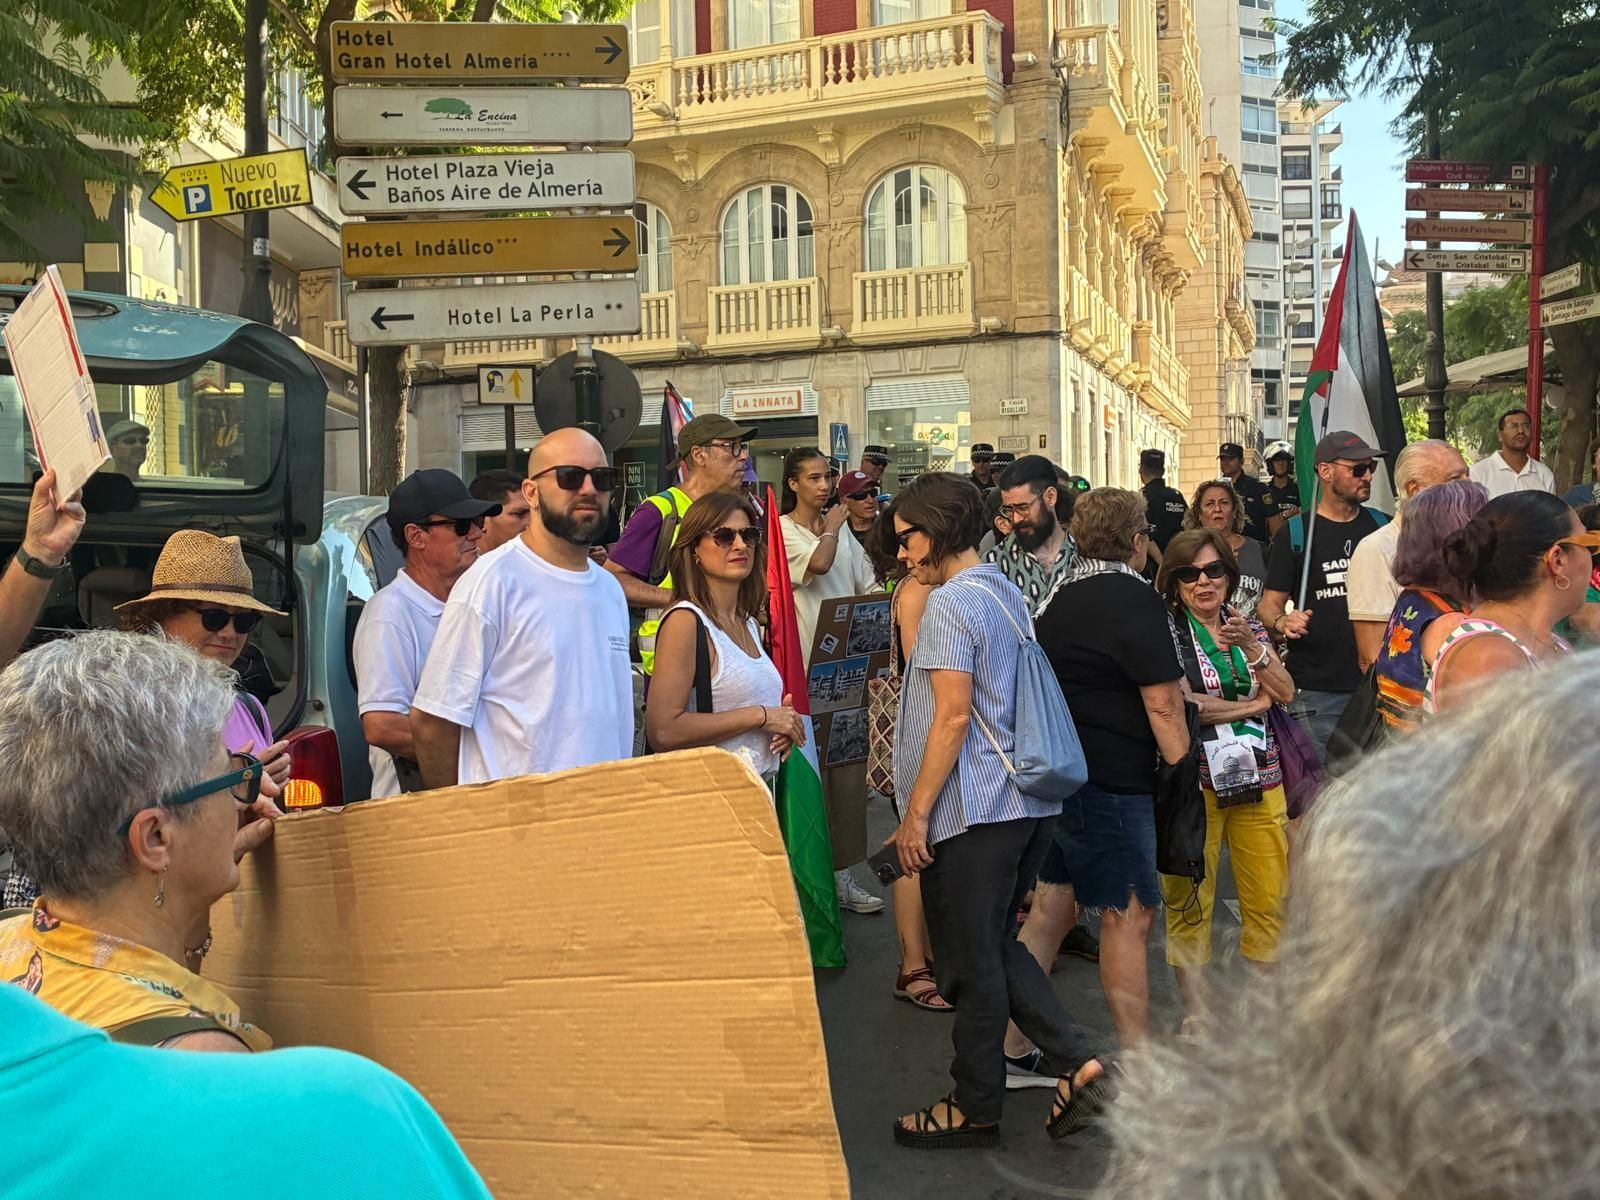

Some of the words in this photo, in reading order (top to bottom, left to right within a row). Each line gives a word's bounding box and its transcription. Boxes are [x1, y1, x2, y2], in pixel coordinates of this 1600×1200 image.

[337, 29, 394, 47] Hotel
[338, 53, 385, 69] Gran
[396, 52, 451, 69] Hotel
[464, 51, 538, 69] Almería
[455, 109, 473, 121] La
[478, 109, 519, 122] Encina
[180, 168, 208, 177] HOTEL
[220, 162, 277, 185] Nuevo
[386, 162, 439, 181] Hotel
[446, 161, 498, 180] Plaza
[504, 159, 555, 180] Vieja
[224, 179, 302, 210] Torreluz
[388, 186, 445, 204] Baños
[451, 184, 491, 201] Aire
[498, 183, 522, 199] de
[528, 179, 603, 198] Almería
[1432, 224, 1459, 233] Puerta
[347, 242, 403, 259] Hotel
[415, 239, 494, 257] Indálico
[1426, 252, 1447, 260] Cerro
[1454, 252, 1467, 260] San
[1474, 252, 1507, 260] Cristobal
[1436, 261, 1450, 269] San
[1456, 261, 1489, 269] Cristobal
[448, 307, 502, 326] Hotel
[511, 306, 532, 323] La
[541, 303, 594, 321] Perla
[1566, 302, 1573, 310] de
[736, 399, 749, 408] LA
[752, 396, 794, 408] INNATA
